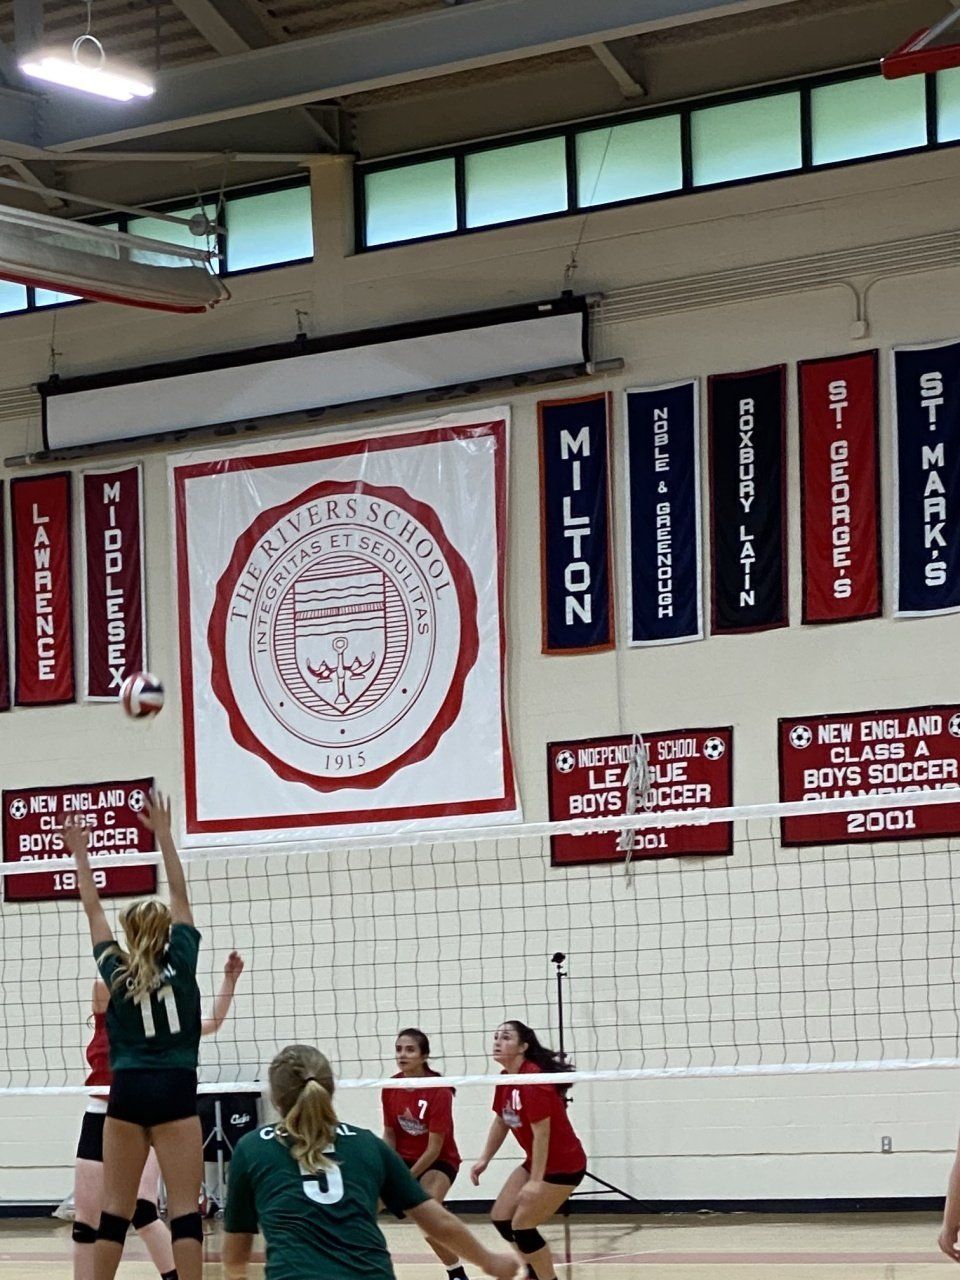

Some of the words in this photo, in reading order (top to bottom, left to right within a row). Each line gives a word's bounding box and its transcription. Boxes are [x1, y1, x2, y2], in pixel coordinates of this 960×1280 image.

[828, 380, 848, 429] ST.
[920, 372, 944, 431] ST.
[654, 407, 670, 472] NOBLE
[740, 398, 755, 513] ROXBURY
[657, 481, 668, 493] &
[560, 426, 592, 625] MILTON
[830, 440, 852, 599] GEORGE'S
[922, 443, 947, 586] MARK'S
[103, 481, 126, 688] MIDDLESEX
[230, 560, 262, 623] THE
[261, 498, 357, 561] RIVERS
[366, 501, 453, 601] SCHOOL
[656, 502, 673, 618] GREENOUGH
[740, 526, 755, 607] LATIN
[33, 503, 55, 681] LAWRENCE
[256, 541, 323, 653] INTEGRITAS
[330, 534, 352, 549] ET
[358, 536, 430, 636] SEDULITAS
[658, 739, 701, 760] SCHOOL
[818, 723, 853, 744] NEW
[861, 715, 942, 742] ENGLAND
[831, 743, 905, 763] CLASS
[914, 741, 930, 757] A
[325, 751, 366, 770] 1915
[804, 766, 862, 789] BOYS
[868, 759, 958, 784] SOCCER
[30, 796, 57, 813] NEW
[63, 790, 125, 812] ENGLAND
[104, 812, 116, 825] C
[569, 792, 622, 815] BOYS
[847, 810, 916, 833] 2001
[19, 833, 65, 852] BOYS
[53, 871, 107, 890] 199
[134, 985, 181, 1038] 11
[418, 1100, 428, 1120] 7
